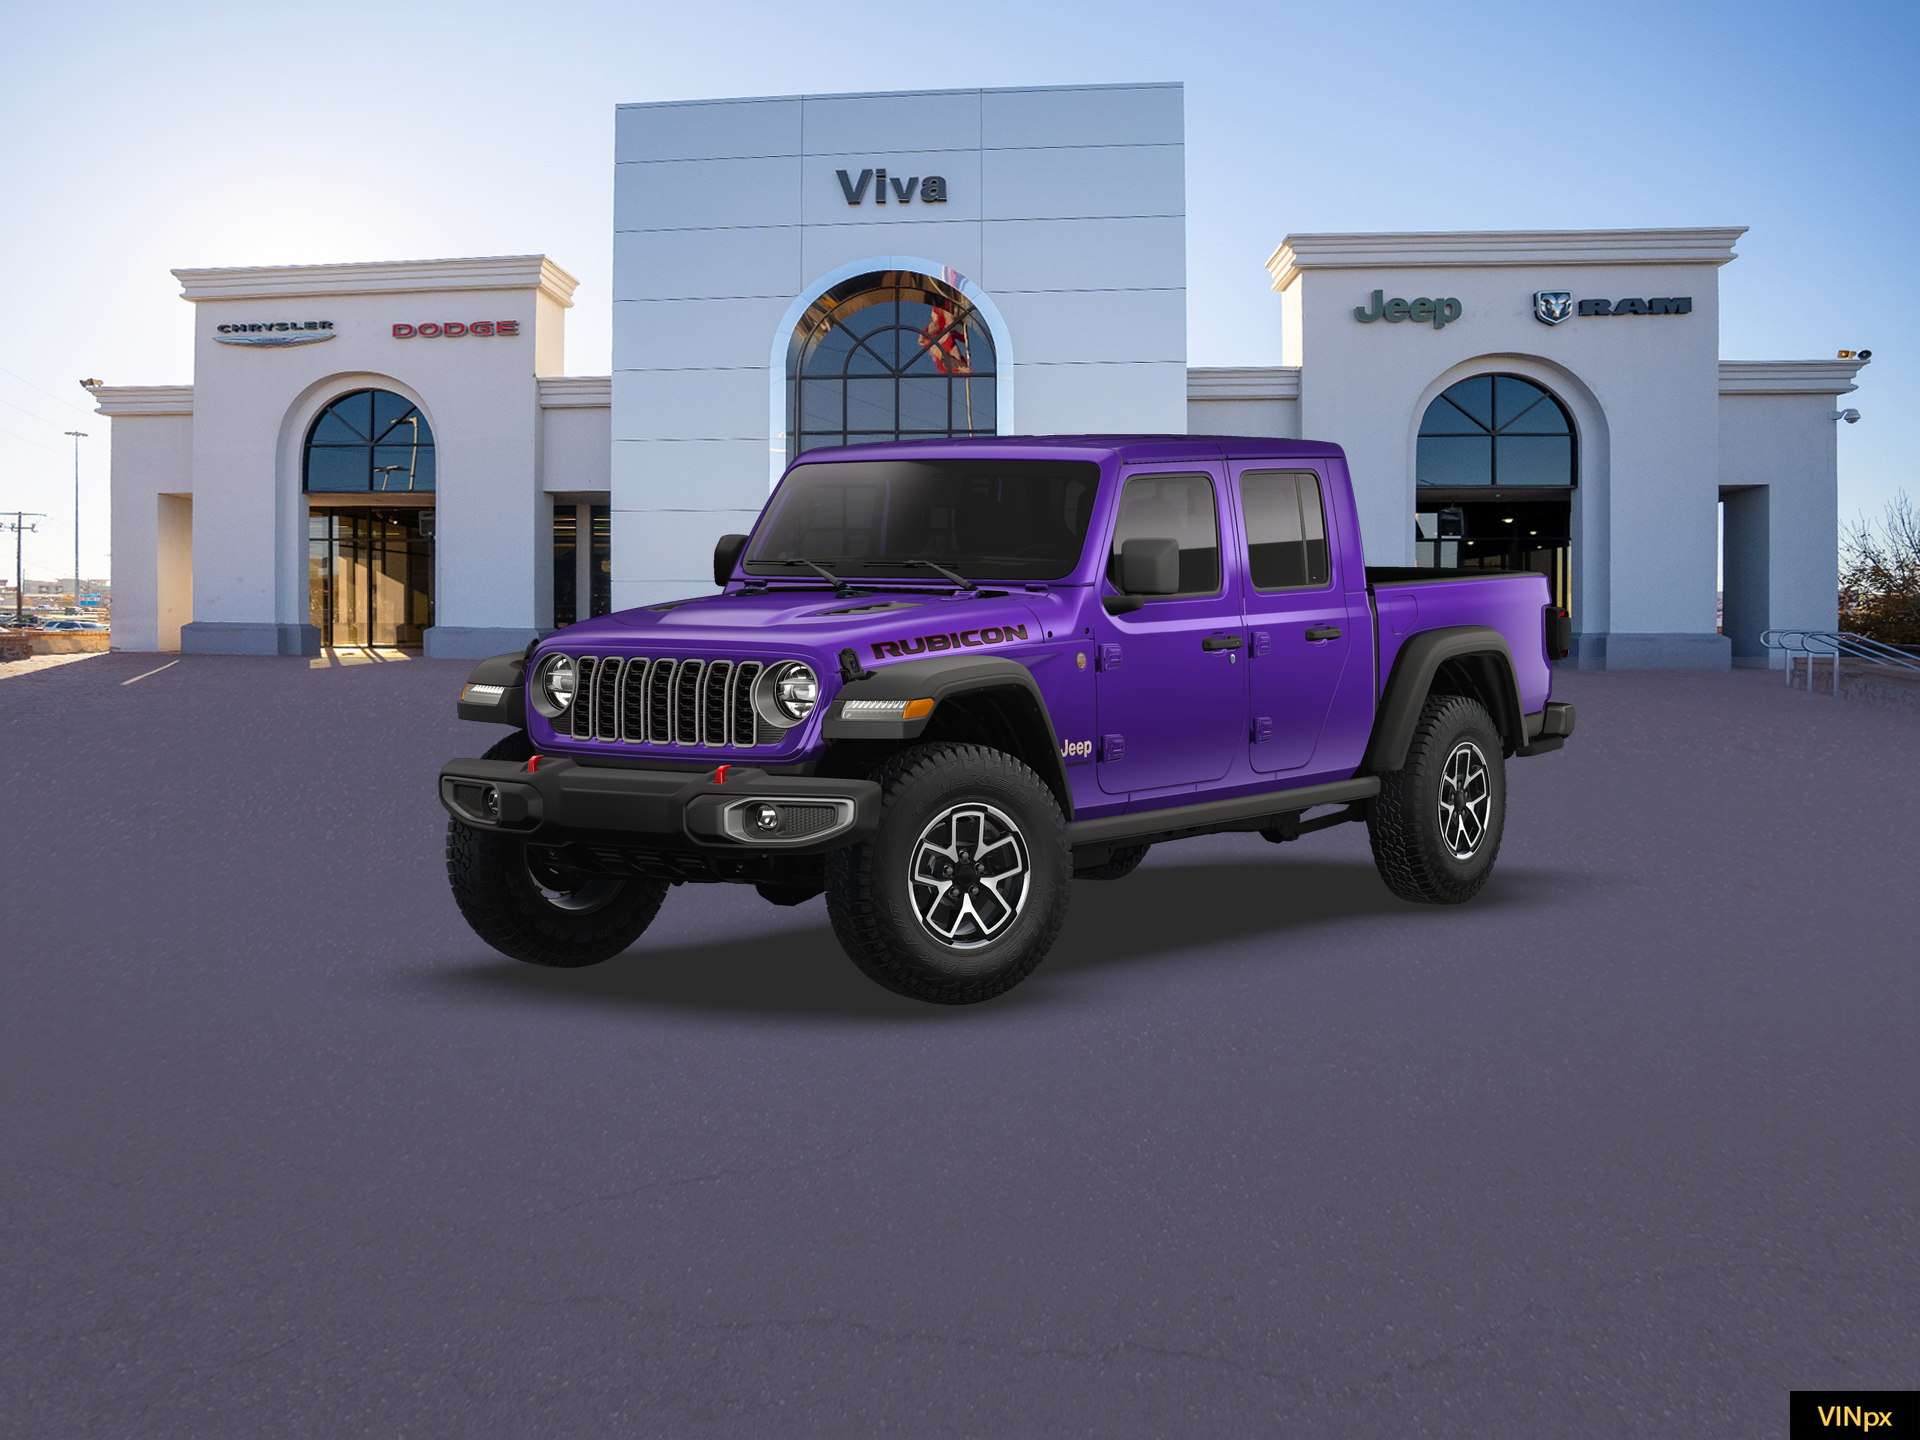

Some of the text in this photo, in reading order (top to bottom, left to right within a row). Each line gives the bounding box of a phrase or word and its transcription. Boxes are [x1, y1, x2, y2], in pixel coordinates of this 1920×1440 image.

[835, 168, 947, 205] Viva
[1354, 289, 1463, 329] Jeep
[1578, 296, 1693, 317] RAM
[217, 320, 334, 334] CHRYSLER
[392, 320, 520, 339] DODGE
[870, 624, 1029, 660] RUBICON
[1060, 738, 1093, 759] Jeep
[911, 773, 1032, 816] FALKEN
